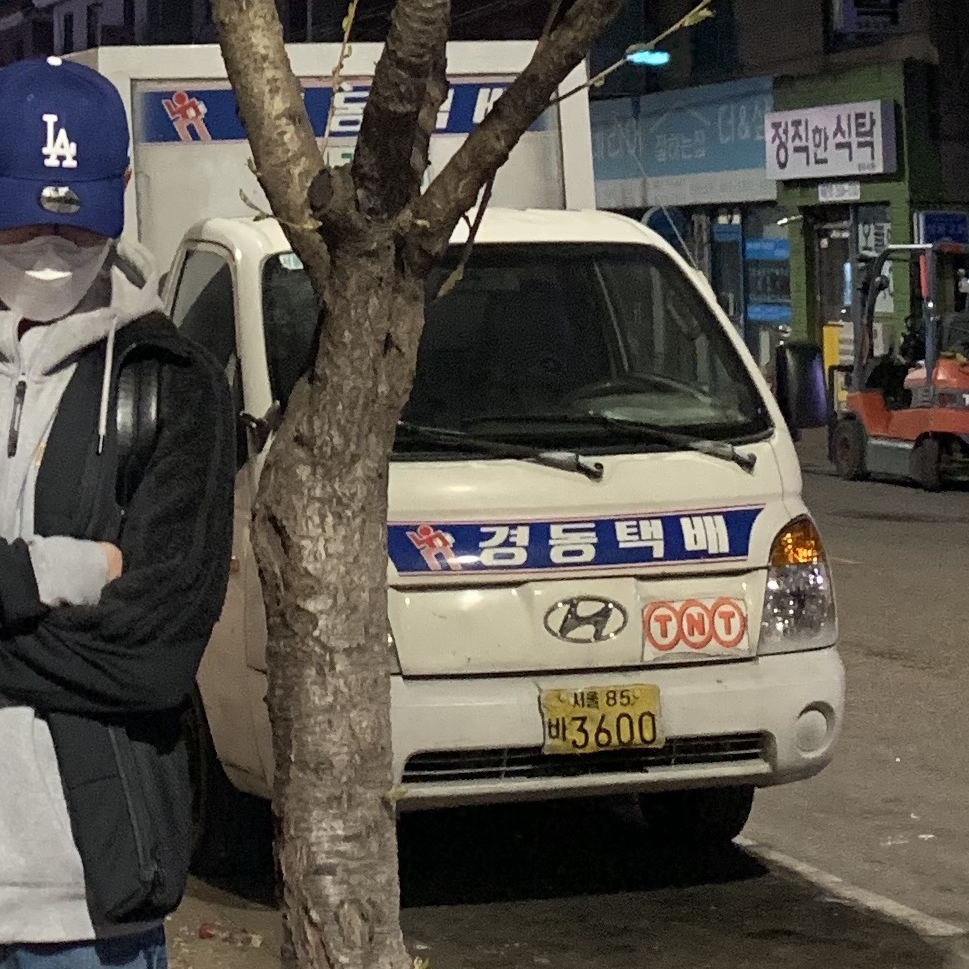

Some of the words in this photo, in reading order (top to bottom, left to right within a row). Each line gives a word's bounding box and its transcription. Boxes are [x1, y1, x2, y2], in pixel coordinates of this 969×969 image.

[42, 113, 78, 168] LA
[479, 515, 730, 567] 경동택배
[652, 606, 739, 642] TNT
[573, 691, 599, 709] 서울
[606, 689, 631, 707] 85
